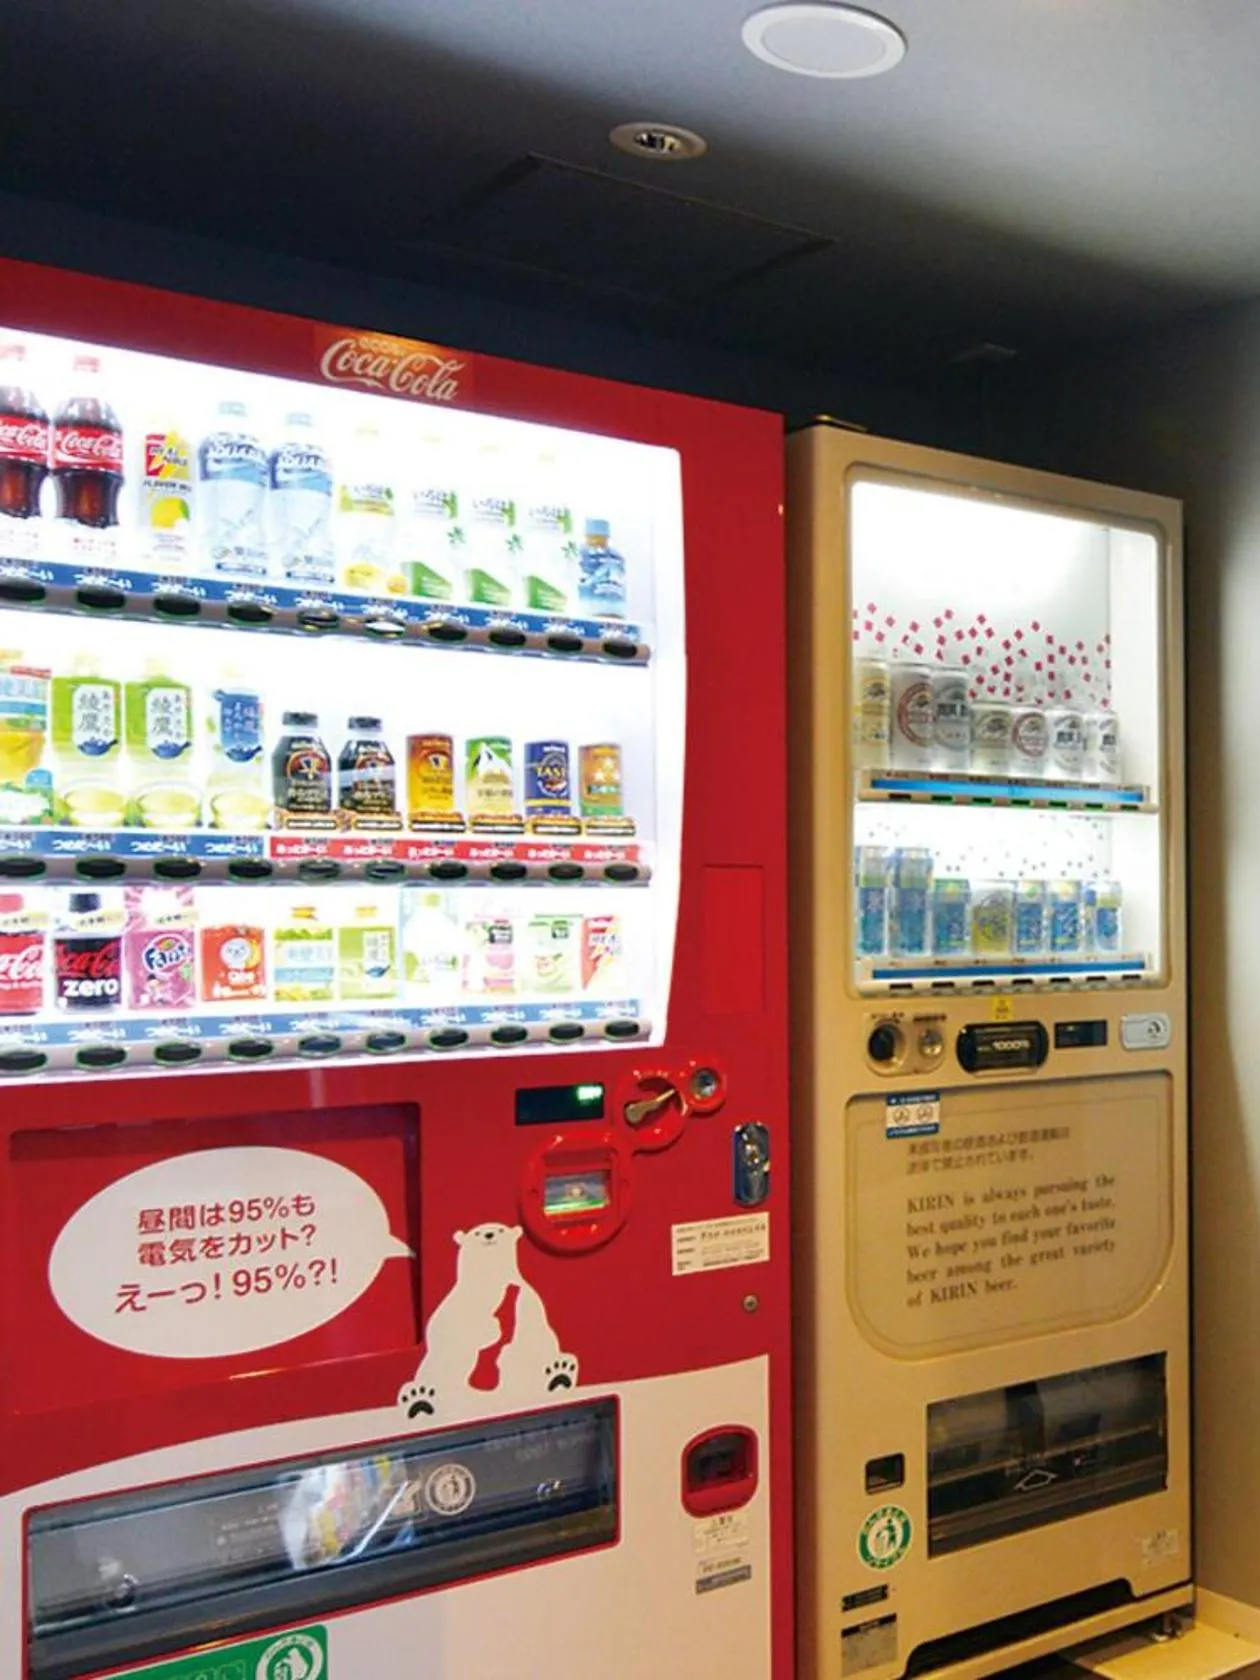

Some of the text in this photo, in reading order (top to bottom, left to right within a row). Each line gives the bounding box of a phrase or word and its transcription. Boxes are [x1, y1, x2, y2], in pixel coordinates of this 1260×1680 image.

[320, 337, 466, 401] Coca-Cola
[63, 976, 119, 998] zero
[907, 1174, 1115, 1214] KIRIN is always pursuing the
[137, 1193, 316, 1235] 昼間は95%も
[906, 1219, 936, 1237] best
[940, 1214, 986, 1234] quality
[992, 1210, 1007, 1223] to
[1009, 1205, 1040, 1222] each
[907, 1217, 1116, 1260] We hope you find your favorite
[907, 1268, 938, 1285] beer
[946, 1258, 992, 1278] among
[1000, 1253, 1024, 1269] the
[1029, 1246, 1066, 1265] great
[907, 1292, 924, 1308] of
[930, 1281, 978, 1304] KIRIN
